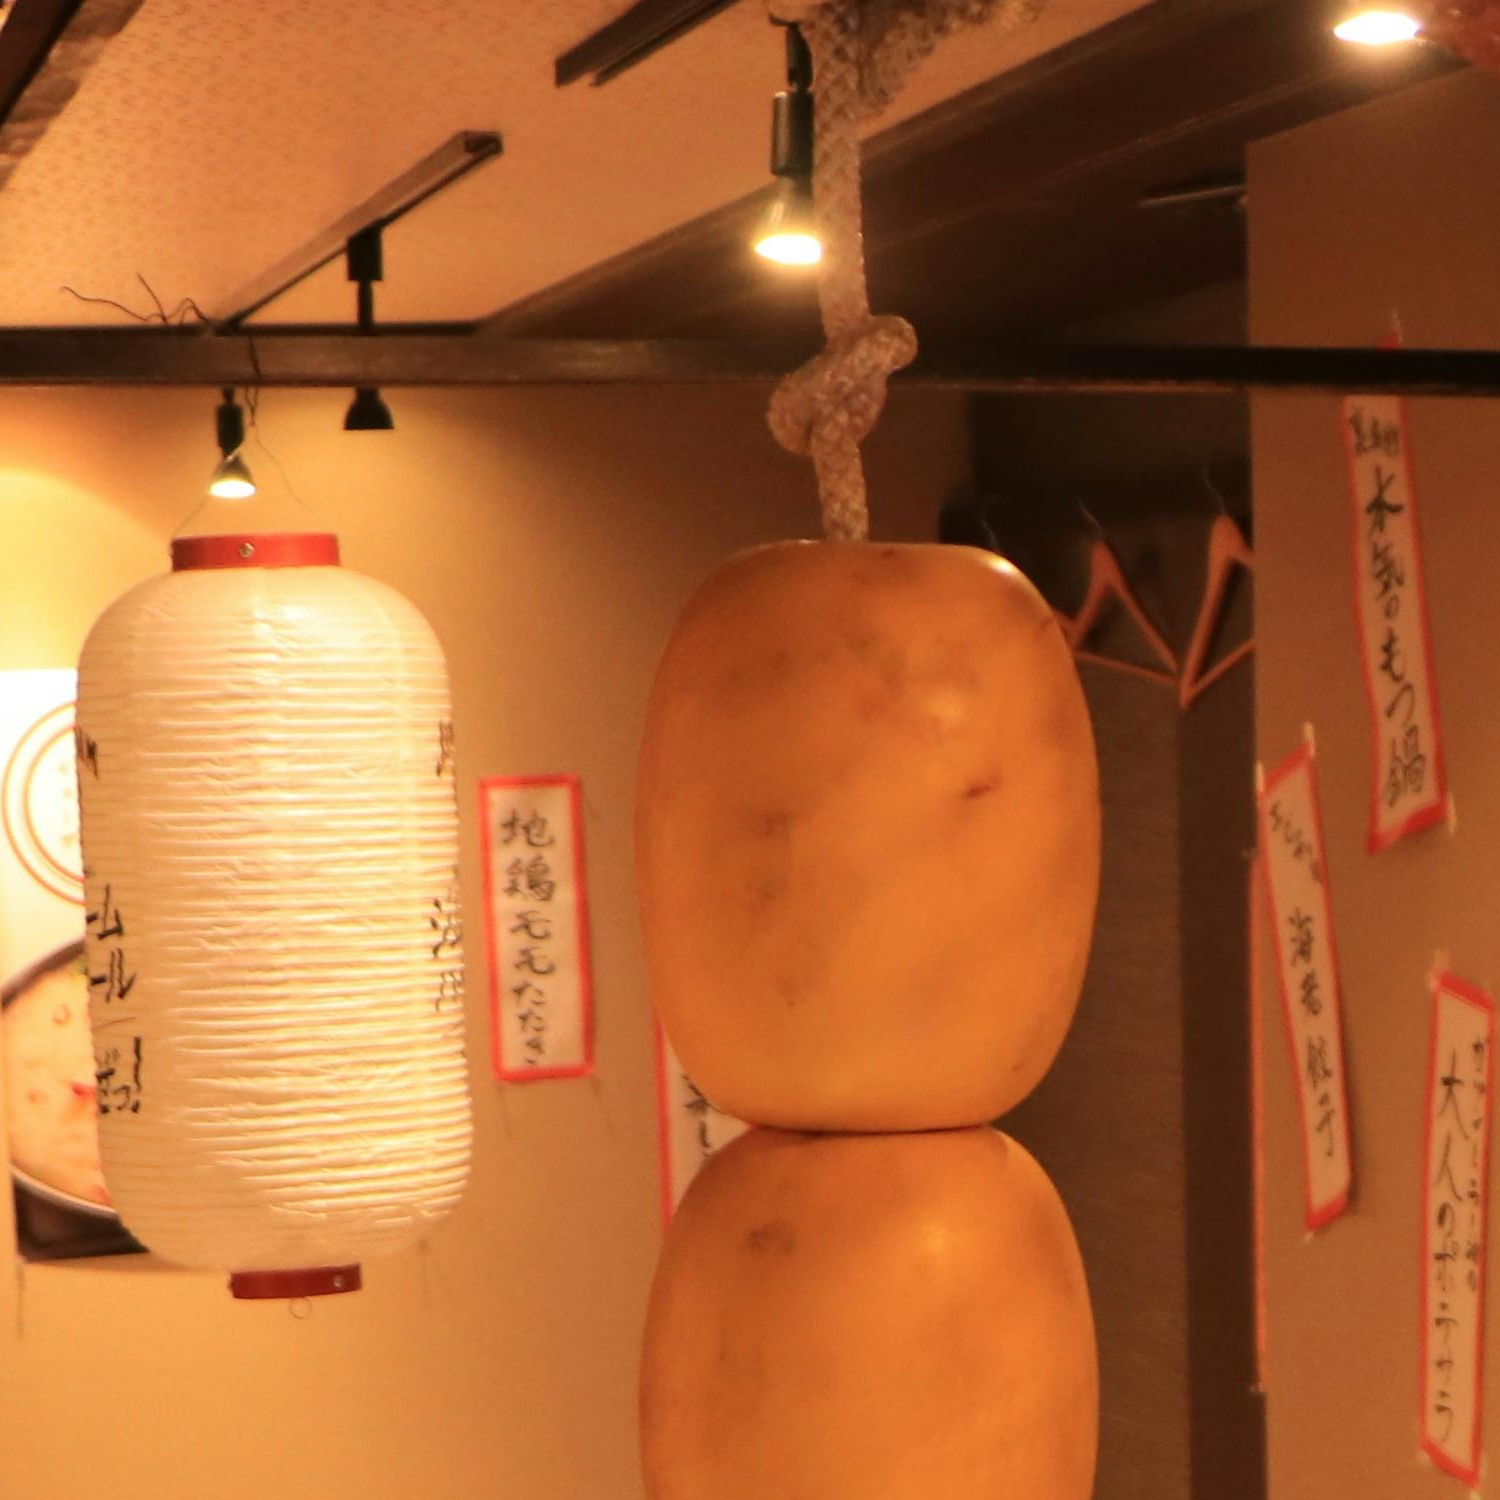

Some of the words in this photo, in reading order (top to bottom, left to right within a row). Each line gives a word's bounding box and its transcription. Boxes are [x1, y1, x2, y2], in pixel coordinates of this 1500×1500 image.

[1436, 1047, 1471, 1443] 大人のポテサラ
